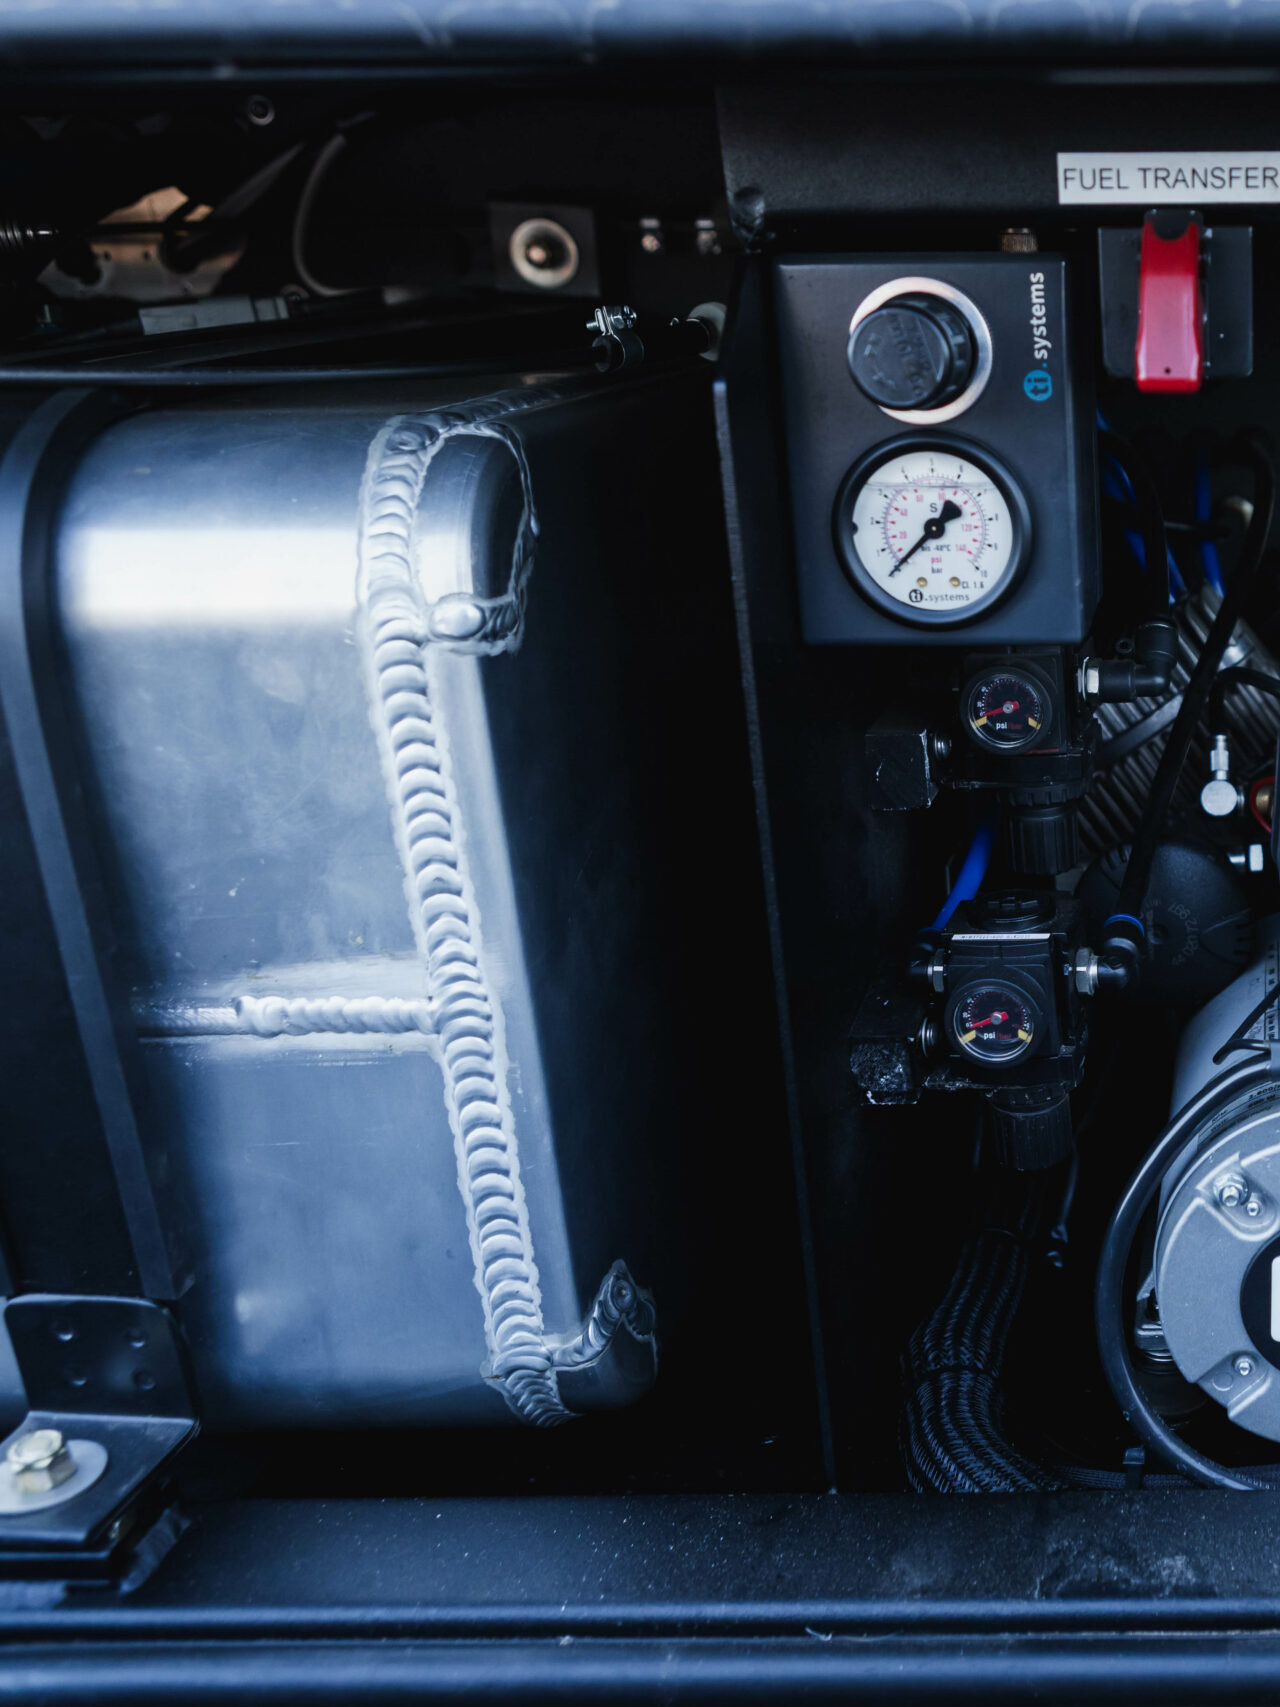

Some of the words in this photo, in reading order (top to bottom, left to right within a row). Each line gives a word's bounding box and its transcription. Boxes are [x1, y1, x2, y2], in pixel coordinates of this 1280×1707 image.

[1063, 167, 1130, 189] FUEL
[1137, 166, 1279, 189] TRANSFER
[929, 502, 938, 513] S
[961, 524, 973, 532] 120
[931, 556, 943, 564] psi
[931, 566, 943, 574] bar
[995, 721, 1008, 731] psi
[983, 1031, 996, 1040] psi
